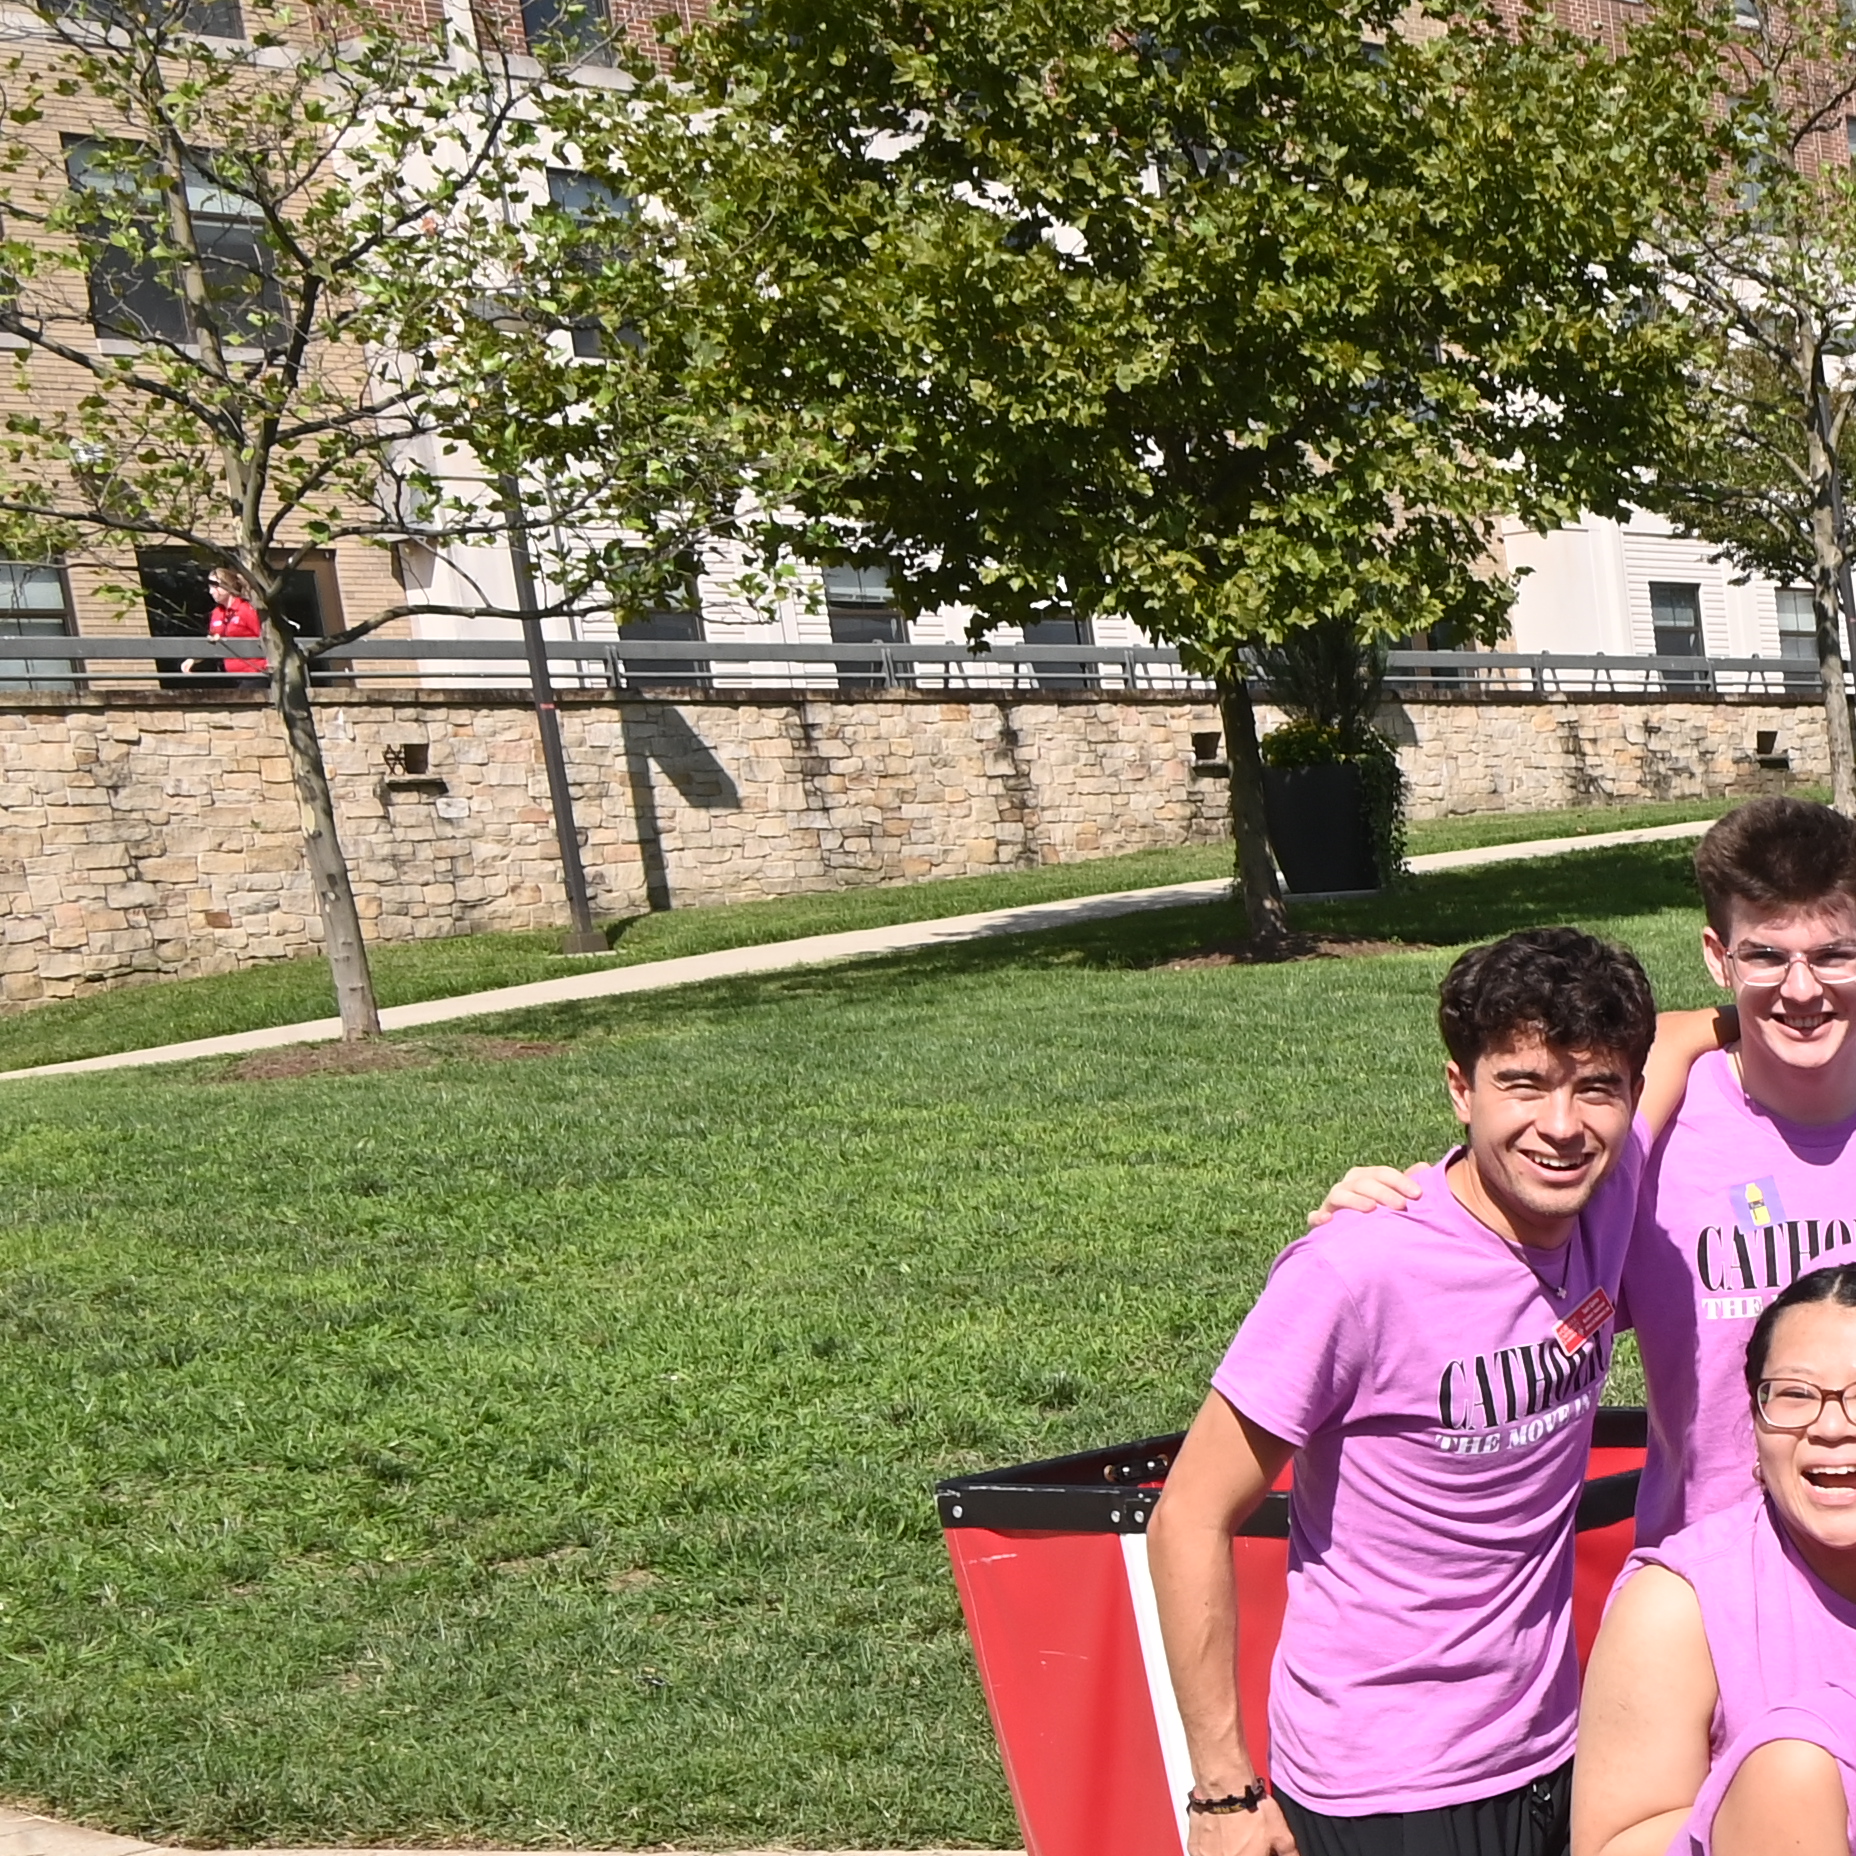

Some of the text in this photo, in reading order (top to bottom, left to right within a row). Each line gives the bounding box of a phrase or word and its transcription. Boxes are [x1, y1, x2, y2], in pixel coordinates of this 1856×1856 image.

[1701, 1296, 1763, 1320] THE
[1435, 1432, 1501, 1456] THE
[1506, 1403, 1571, 1451] MOVE
